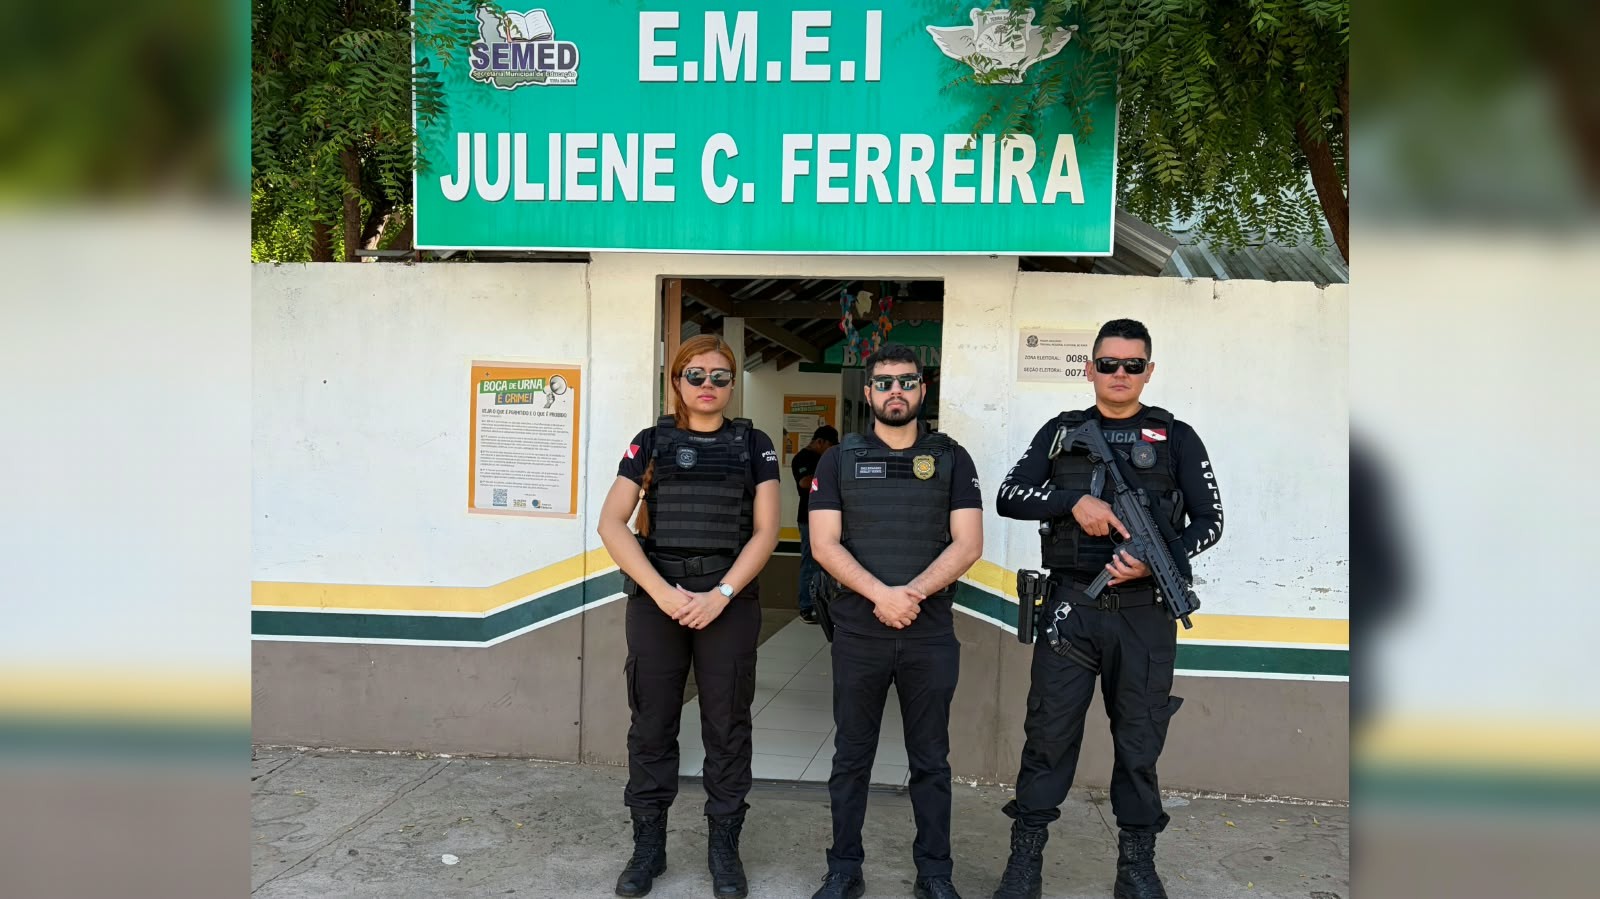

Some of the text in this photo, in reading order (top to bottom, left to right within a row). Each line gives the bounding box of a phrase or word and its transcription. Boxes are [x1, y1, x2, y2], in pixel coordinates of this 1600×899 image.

[638, 9, 883, 82] E.M.E.I
[471, 42, 577, 70] SEMED
[440, 132, 1085, 205] JULIENE C. FERREIRA
[1066, 354, 1089, 363] 0089
[1065, 368, 1087, 377] 0071
[483, 380, 508, 392] BOCA
[517, 378, 543, 390] URNA
[497, 392, 533, 404] É CRIME!
